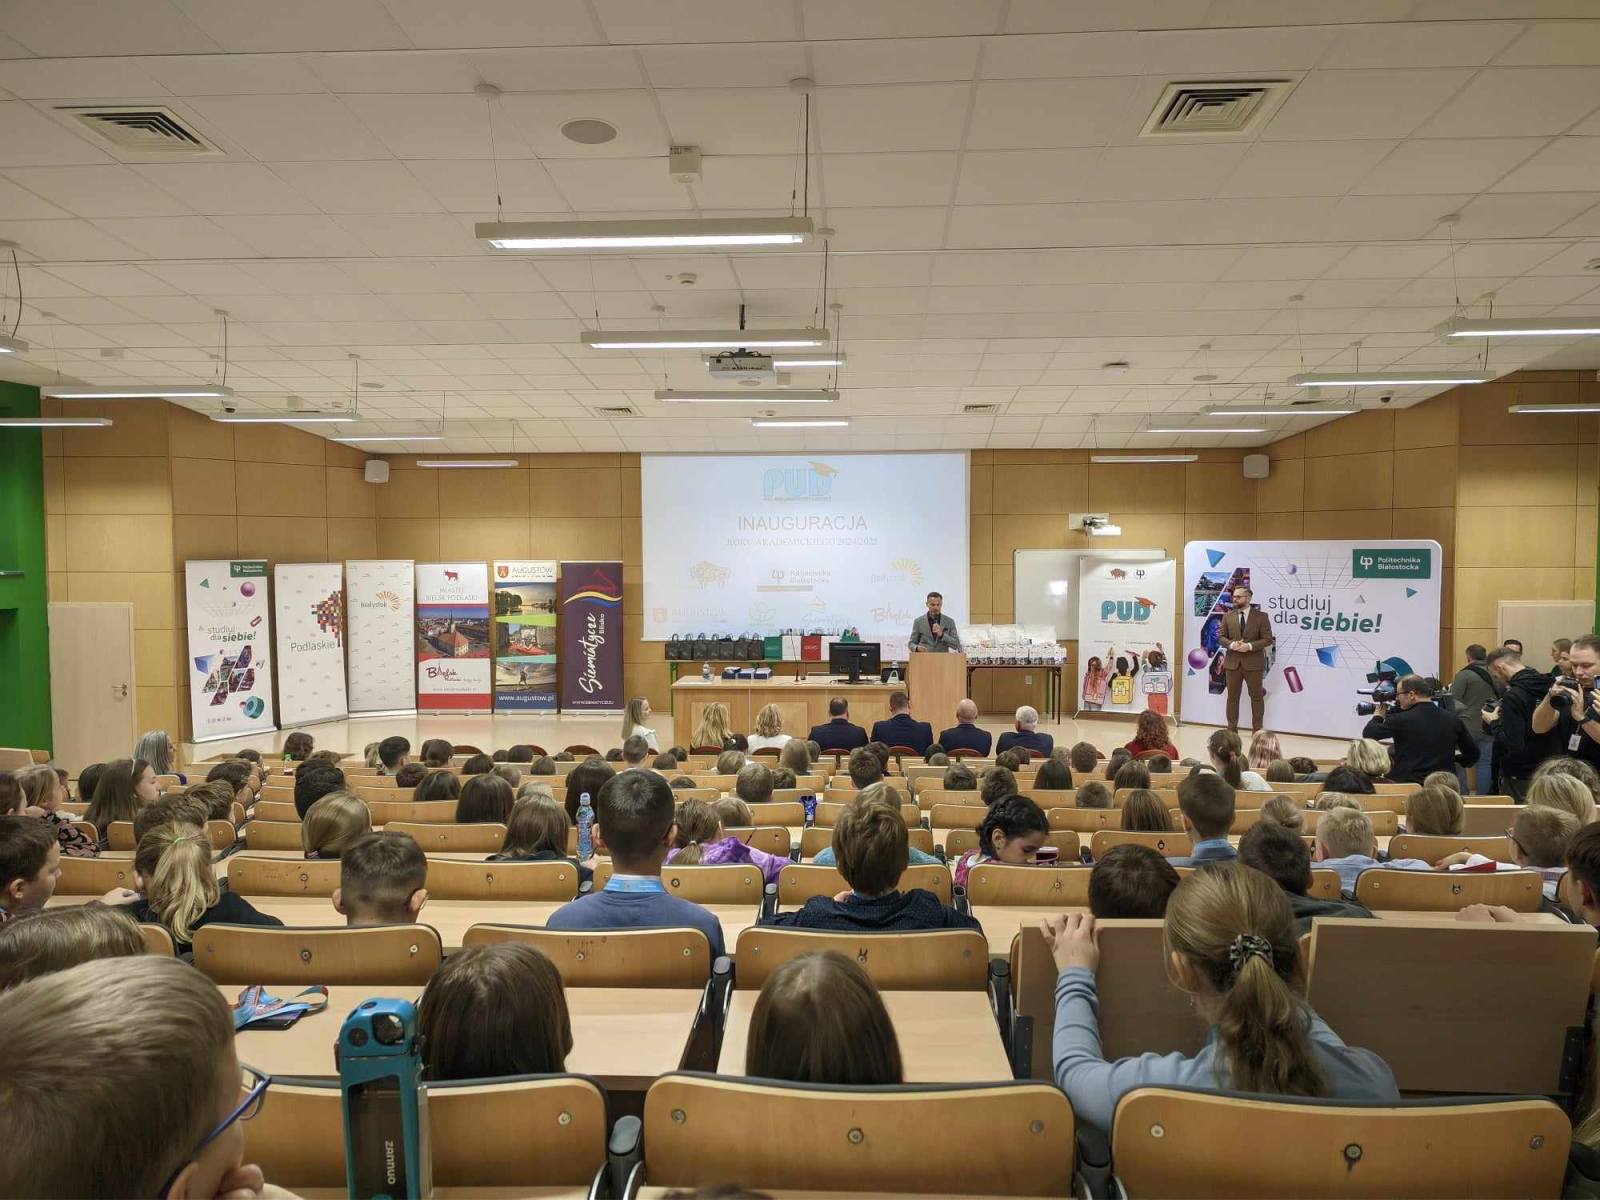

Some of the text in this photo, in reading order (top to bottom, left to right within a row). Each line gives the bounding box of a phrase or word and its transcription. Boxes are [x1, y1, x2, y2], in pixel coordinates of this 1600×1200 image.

[738, 515, 868, 531] INAUGURACJA
[1377, 556, 1421, 564] Politechnika
[1101, 600, 1151, 622] PUD
[1268, 593, 1331, 616] studiuj
[1273, 610, 1383, 633] dla siebie!
[207, 625, 236, 635] studiuj
[222, 631, 257, 642] siebie!
[290, 640, 336, 653] Podlaskie
[578, 611, 605, 694] Siemiatycze
[498, 694, 555, 703] www.augustow.pl
